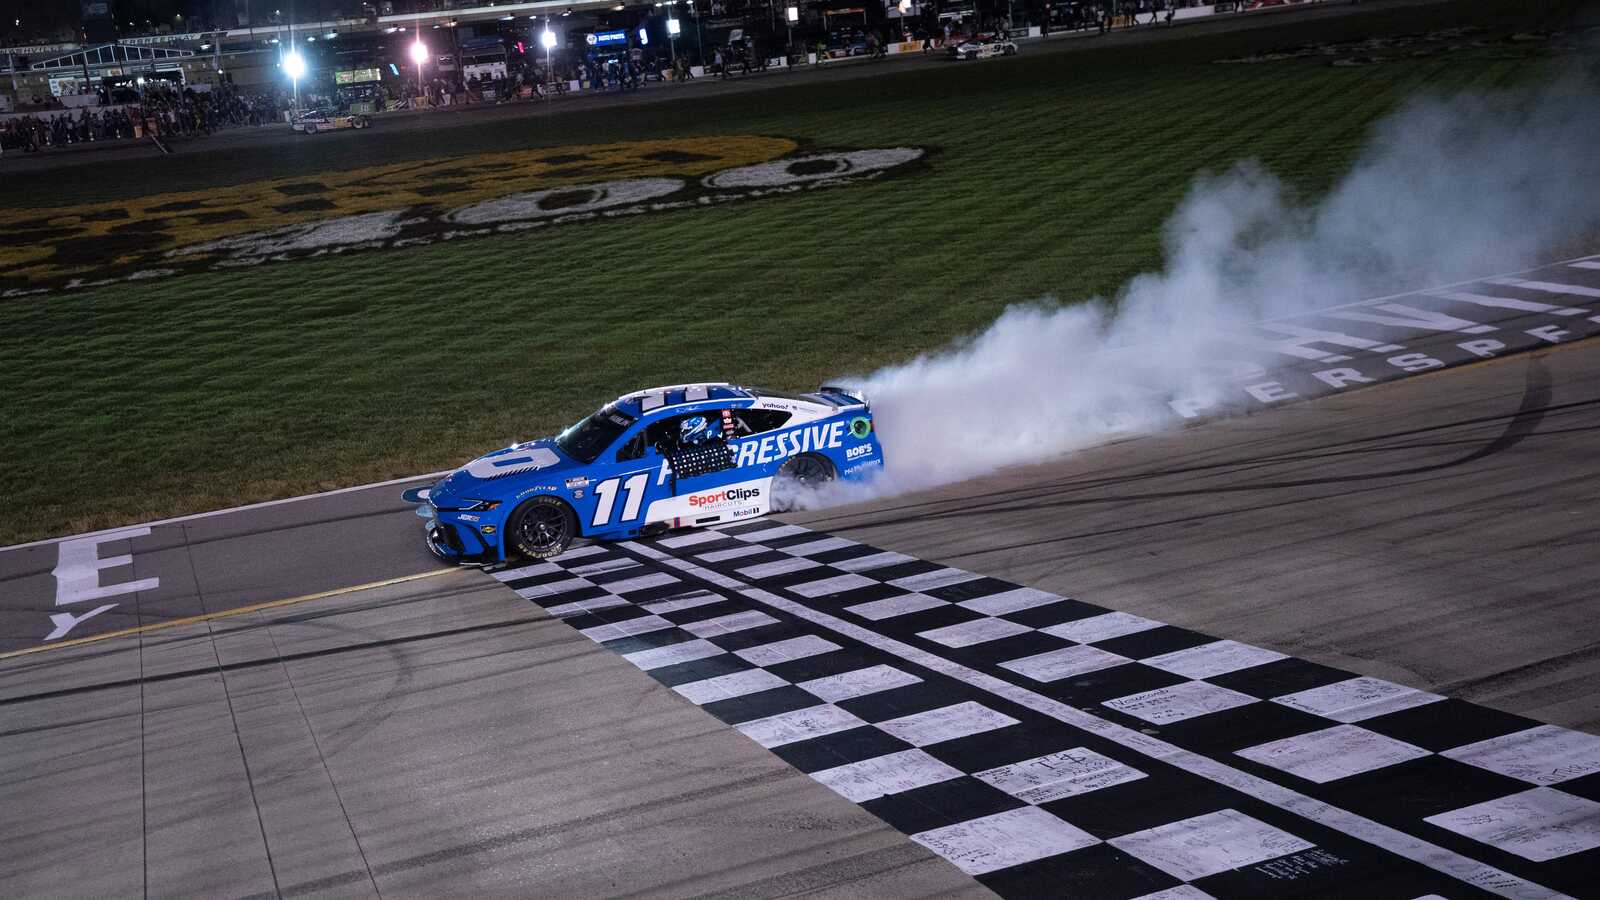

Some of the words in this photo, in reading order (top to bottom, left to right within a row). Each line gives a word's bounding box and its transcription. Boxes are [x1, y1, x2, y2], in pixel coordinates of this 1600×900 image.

[762, 402, 788, 410] yahoo!
[846, 443, 872, 458] BOB'S
[592, 473, 649, 527] 11
[688, 488, 760, 507] SportClips
[733, 508, 752, 518] Mobil
